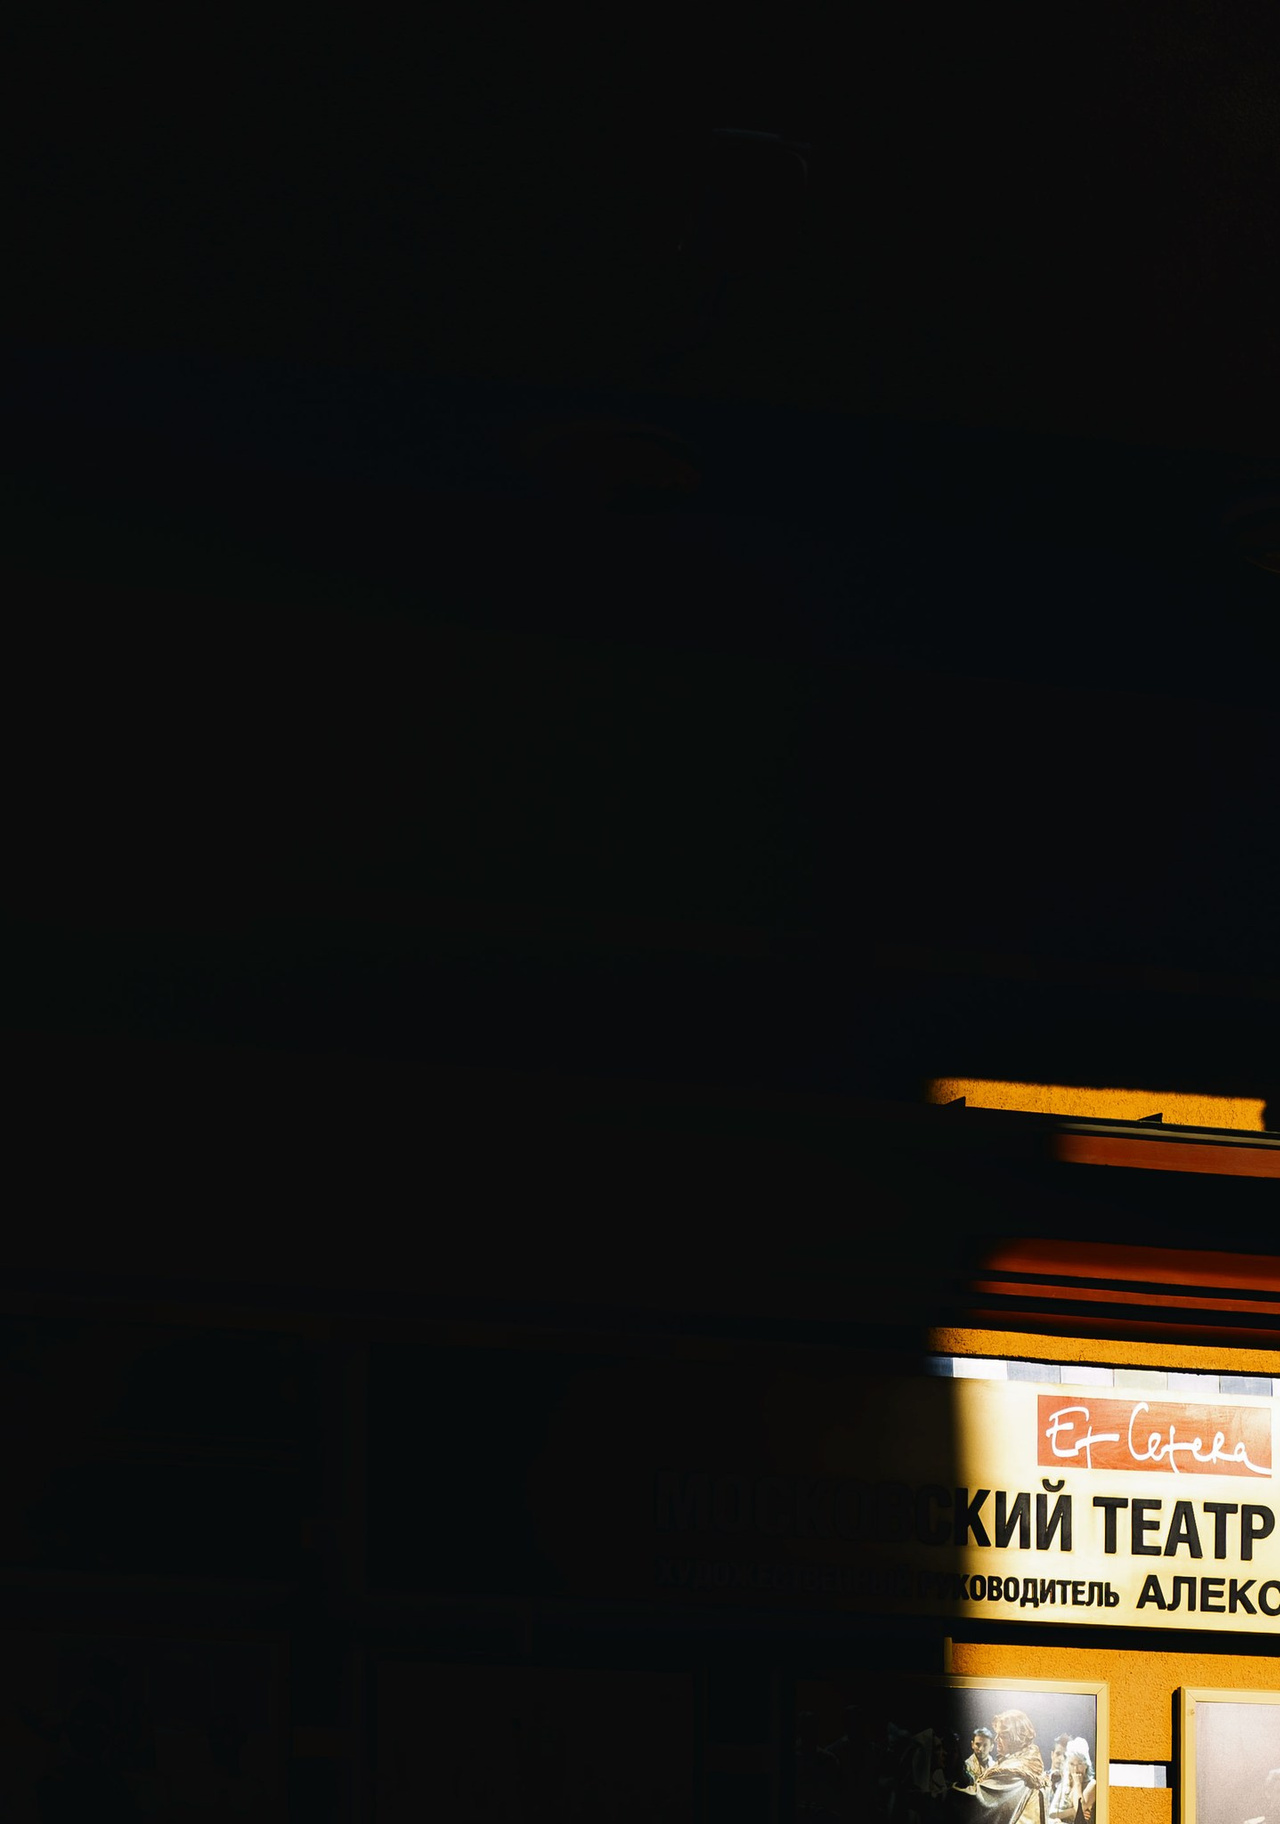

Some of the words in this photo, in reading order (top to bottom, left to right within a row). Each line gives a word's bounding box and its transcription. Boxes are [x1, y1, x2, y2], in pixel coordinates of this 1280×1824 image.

[1046, 1406, 1120, 1469] Et
[1128, 1401, 1273, 1474] Cetera
[1092, 1496, 1276, 1561] ТЕАТР
